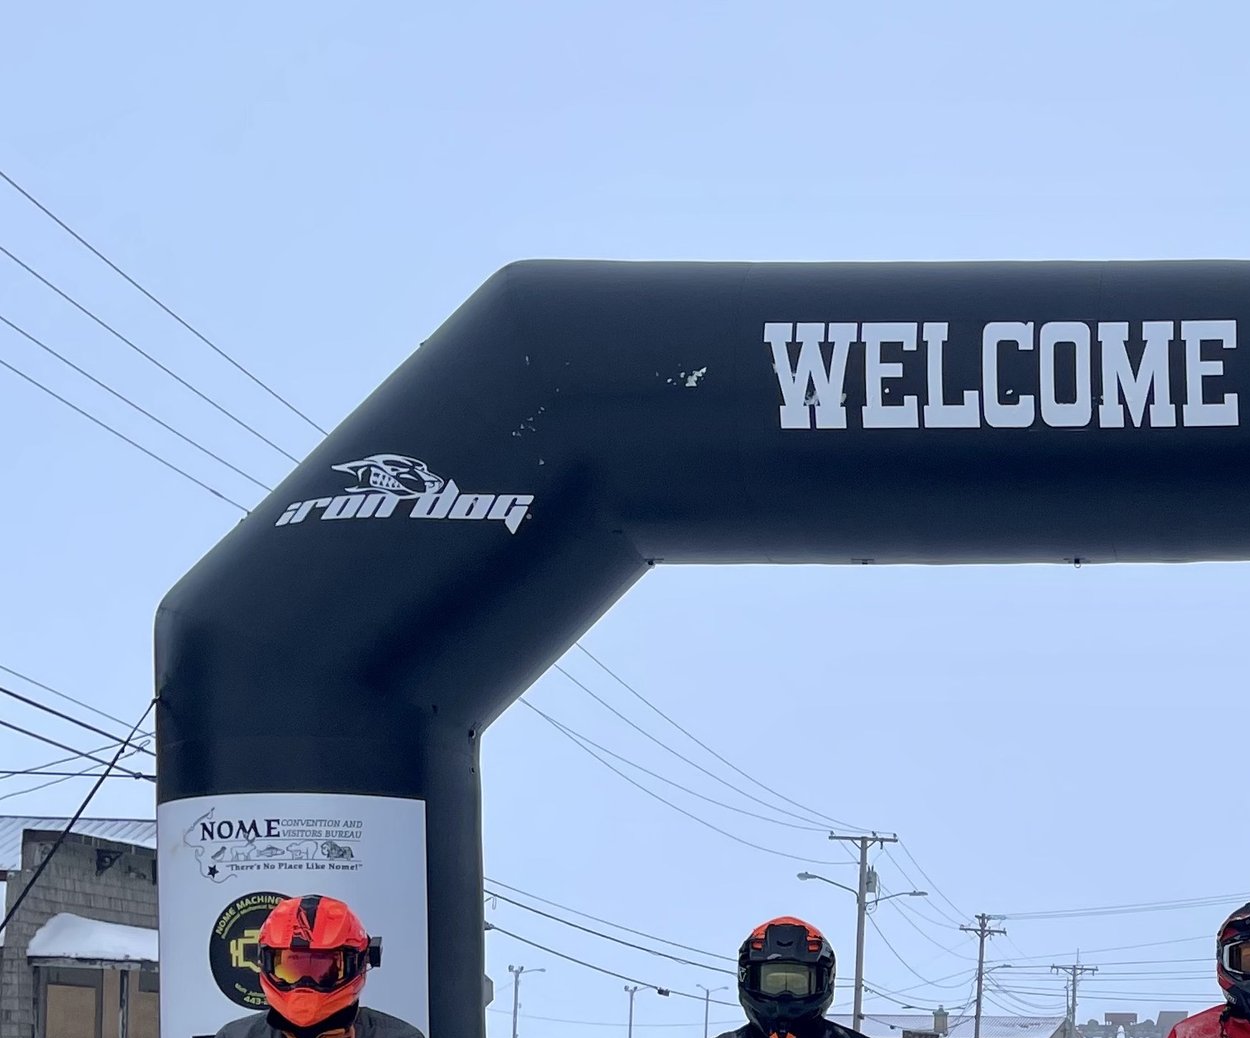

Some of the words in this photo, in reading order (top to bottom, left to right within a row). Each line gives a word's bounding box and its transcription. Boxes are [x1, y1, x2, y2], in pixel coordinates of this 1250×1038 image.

[764, 320, 1239, 429] WELCOME
[200, 819, 280, 841] NOME
[281, 819, 340, 828] CONVENTION
[343, 820, 363, 828] AND
[282, 829, 322, 838] VISITORS
[325, 830, 362, 839] BUREAU
[279, 862, 303, 870] Place
[306, 862, 325, 870] Like
[215, 907, 236, 935] NOME
